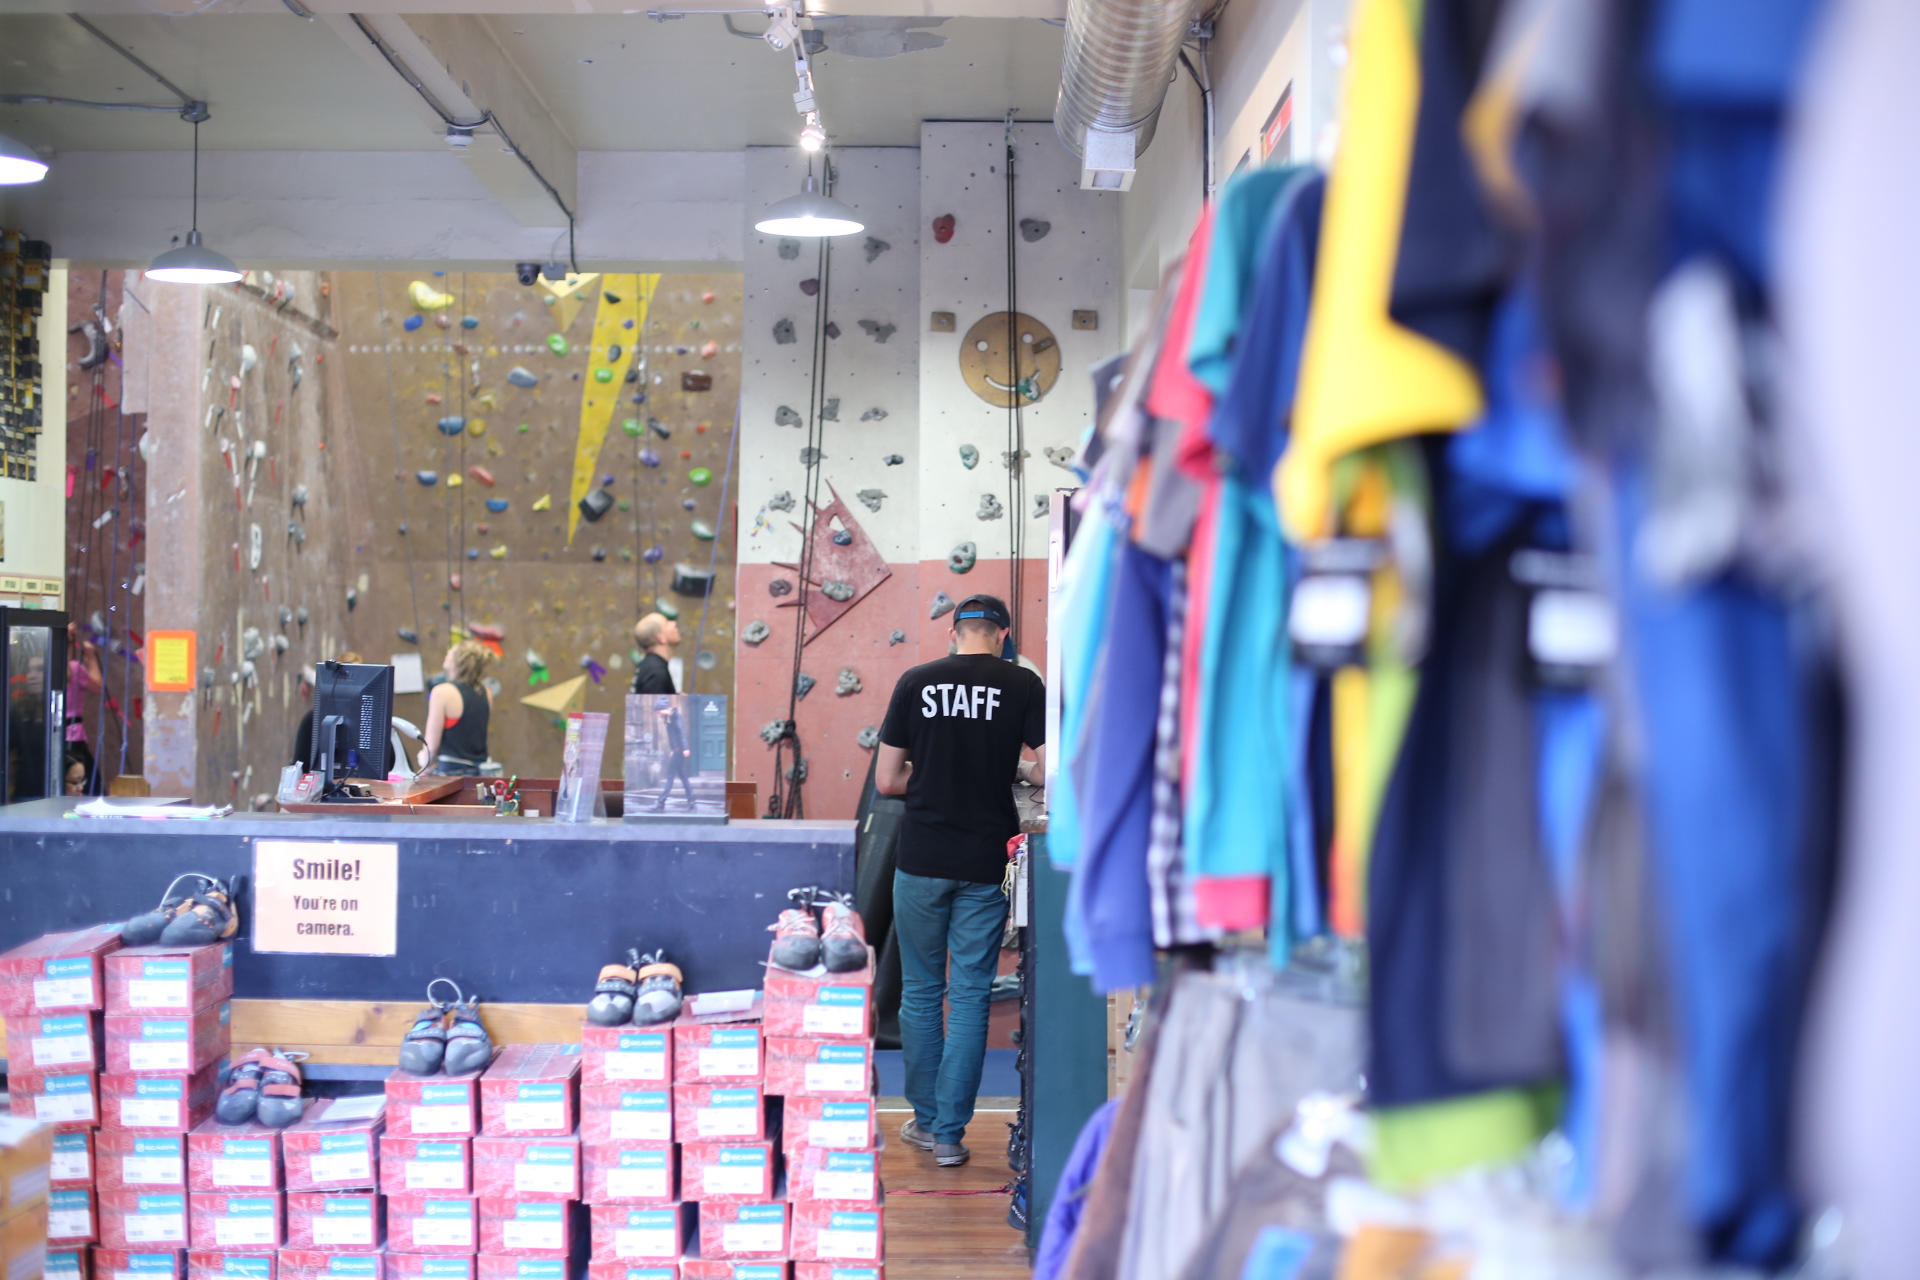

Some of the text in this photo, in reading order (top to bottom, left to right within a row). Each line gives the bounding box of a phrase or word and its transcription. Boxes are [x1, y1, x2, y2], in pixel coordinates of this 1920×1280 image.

[922, 684, 1001, 720] STAFF
[293, 858, 360, 881] Smile!
[293, 895, 358, 911] You're on
[297, 922, 354, 936] camera.
